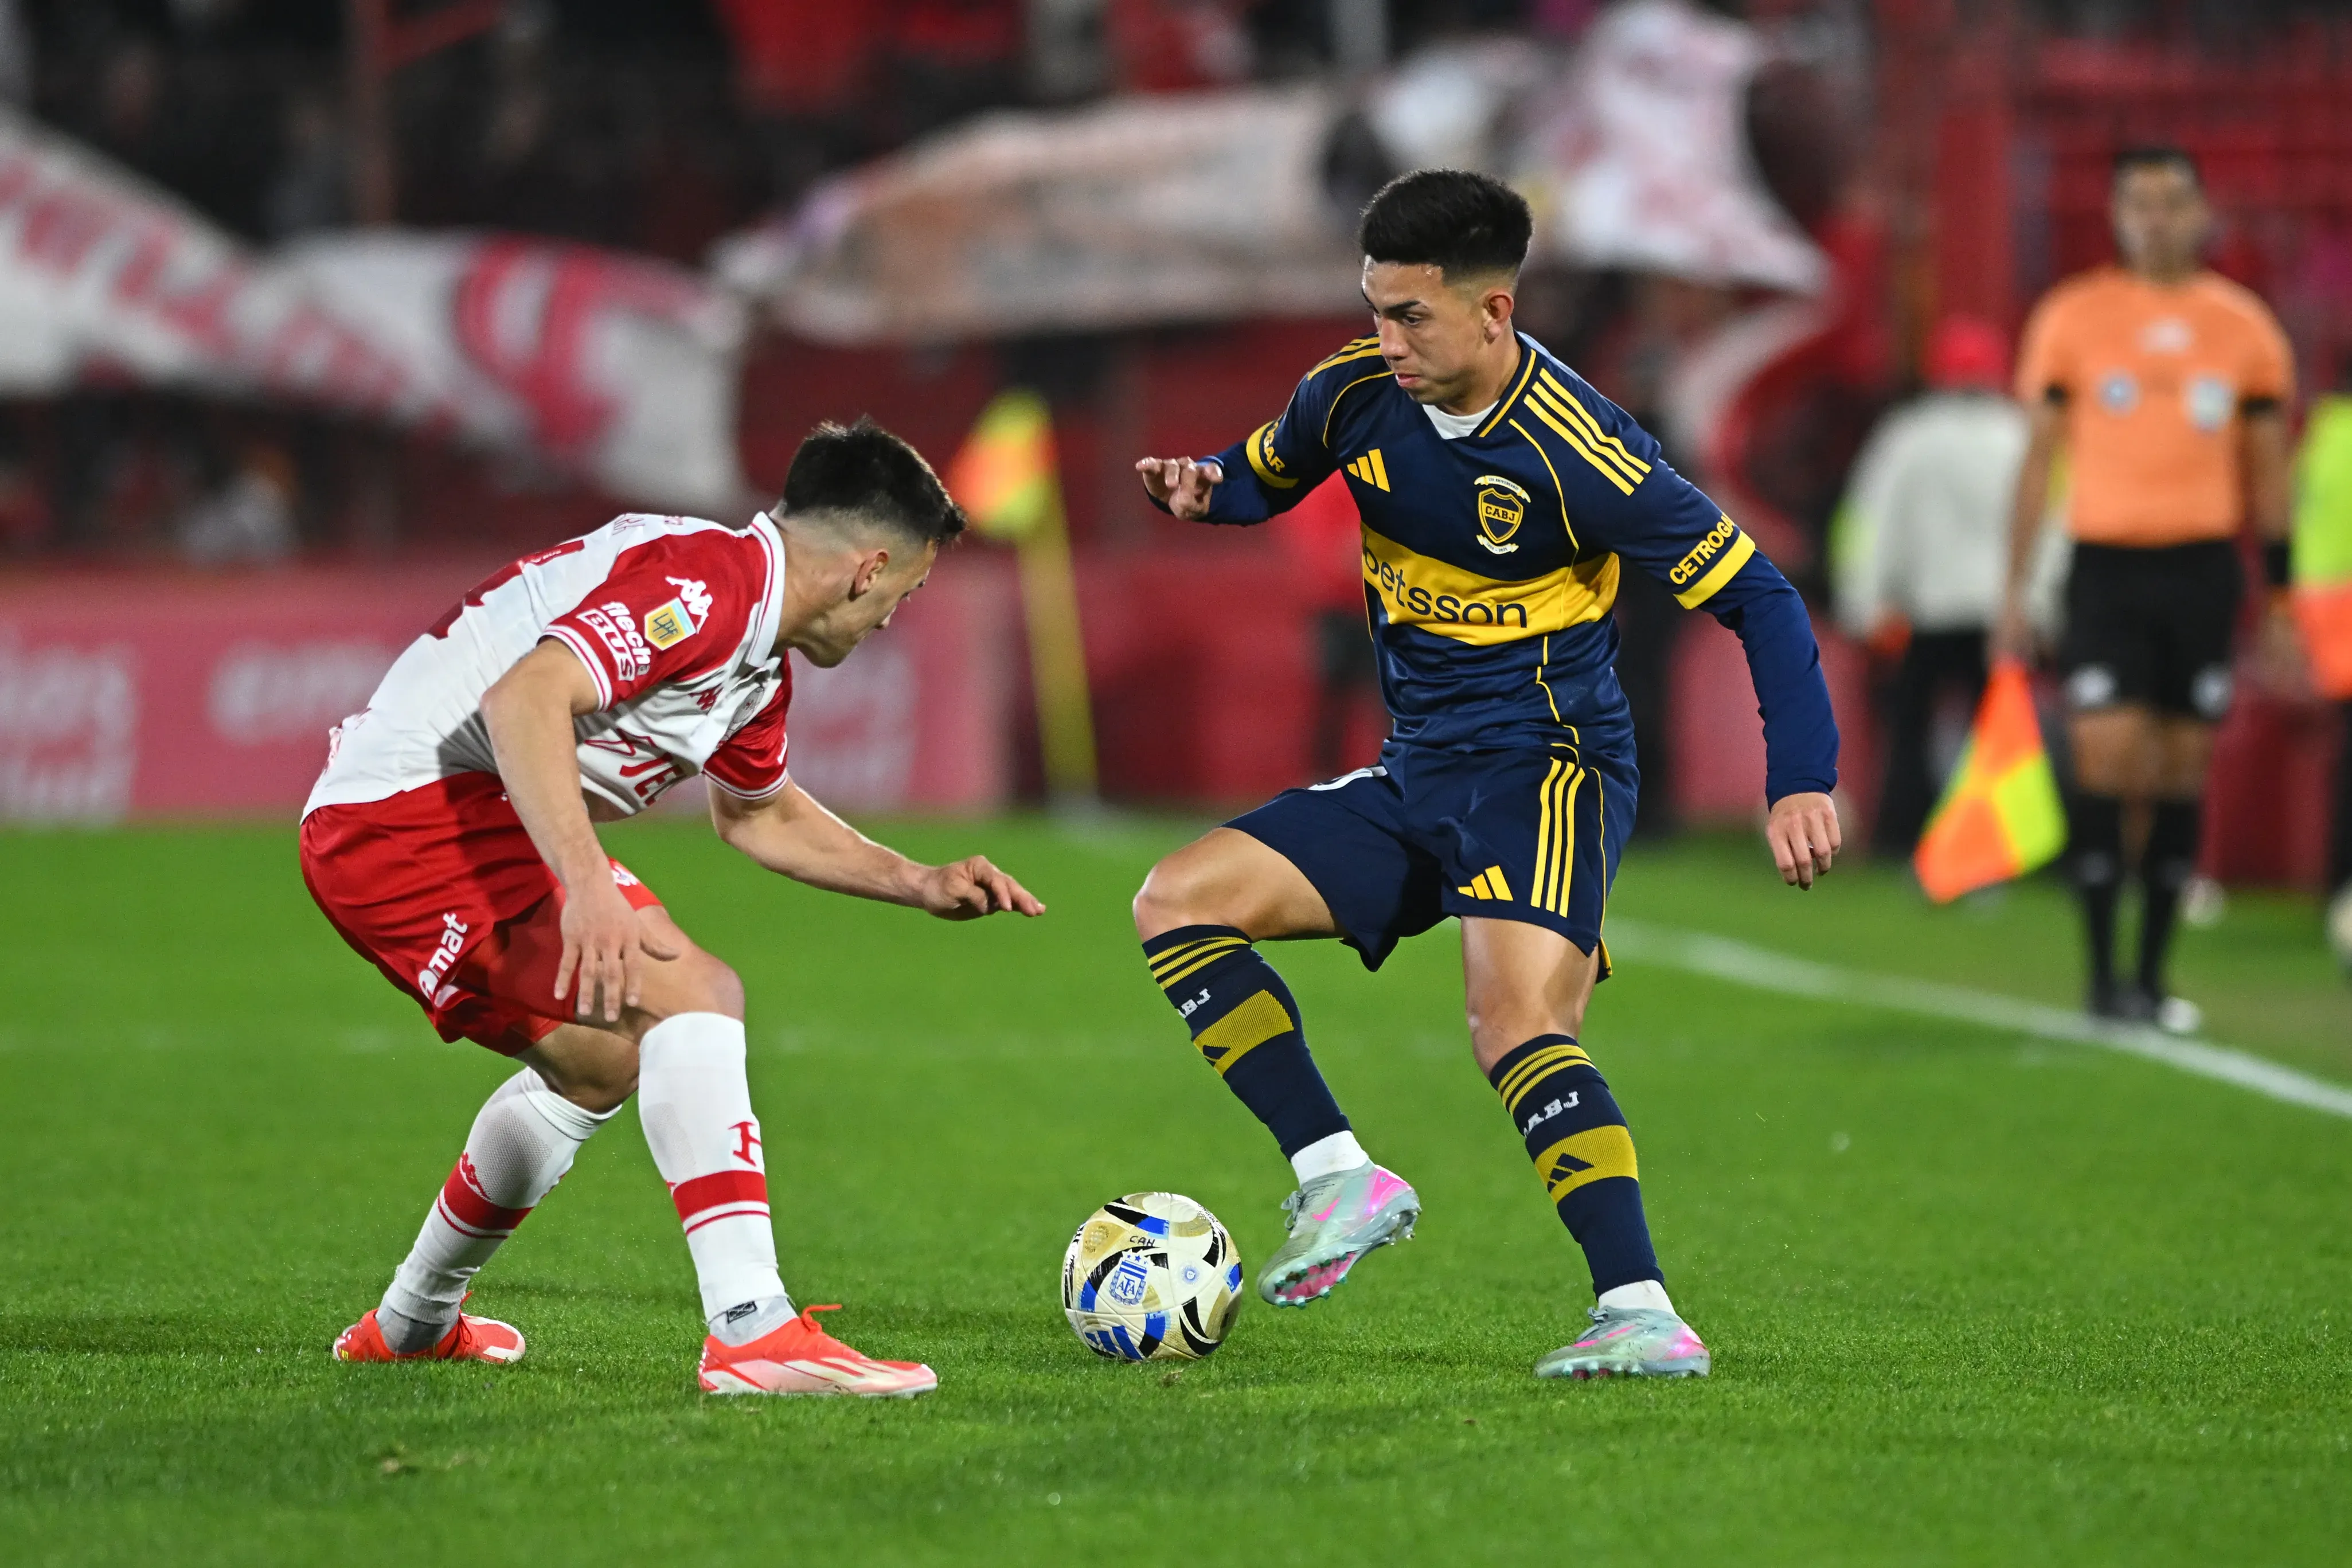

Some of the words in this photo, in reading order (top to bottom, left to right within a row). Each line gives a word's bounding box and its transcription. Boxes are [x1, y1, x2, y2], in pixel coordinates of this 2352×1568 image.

[1485, 506, 1515, 521] CABJ
[1669, 512, 1734, 584] CETROGA
[1363, 534, 1527, 628] betsson
[584, 612, 632, 678] BUS
